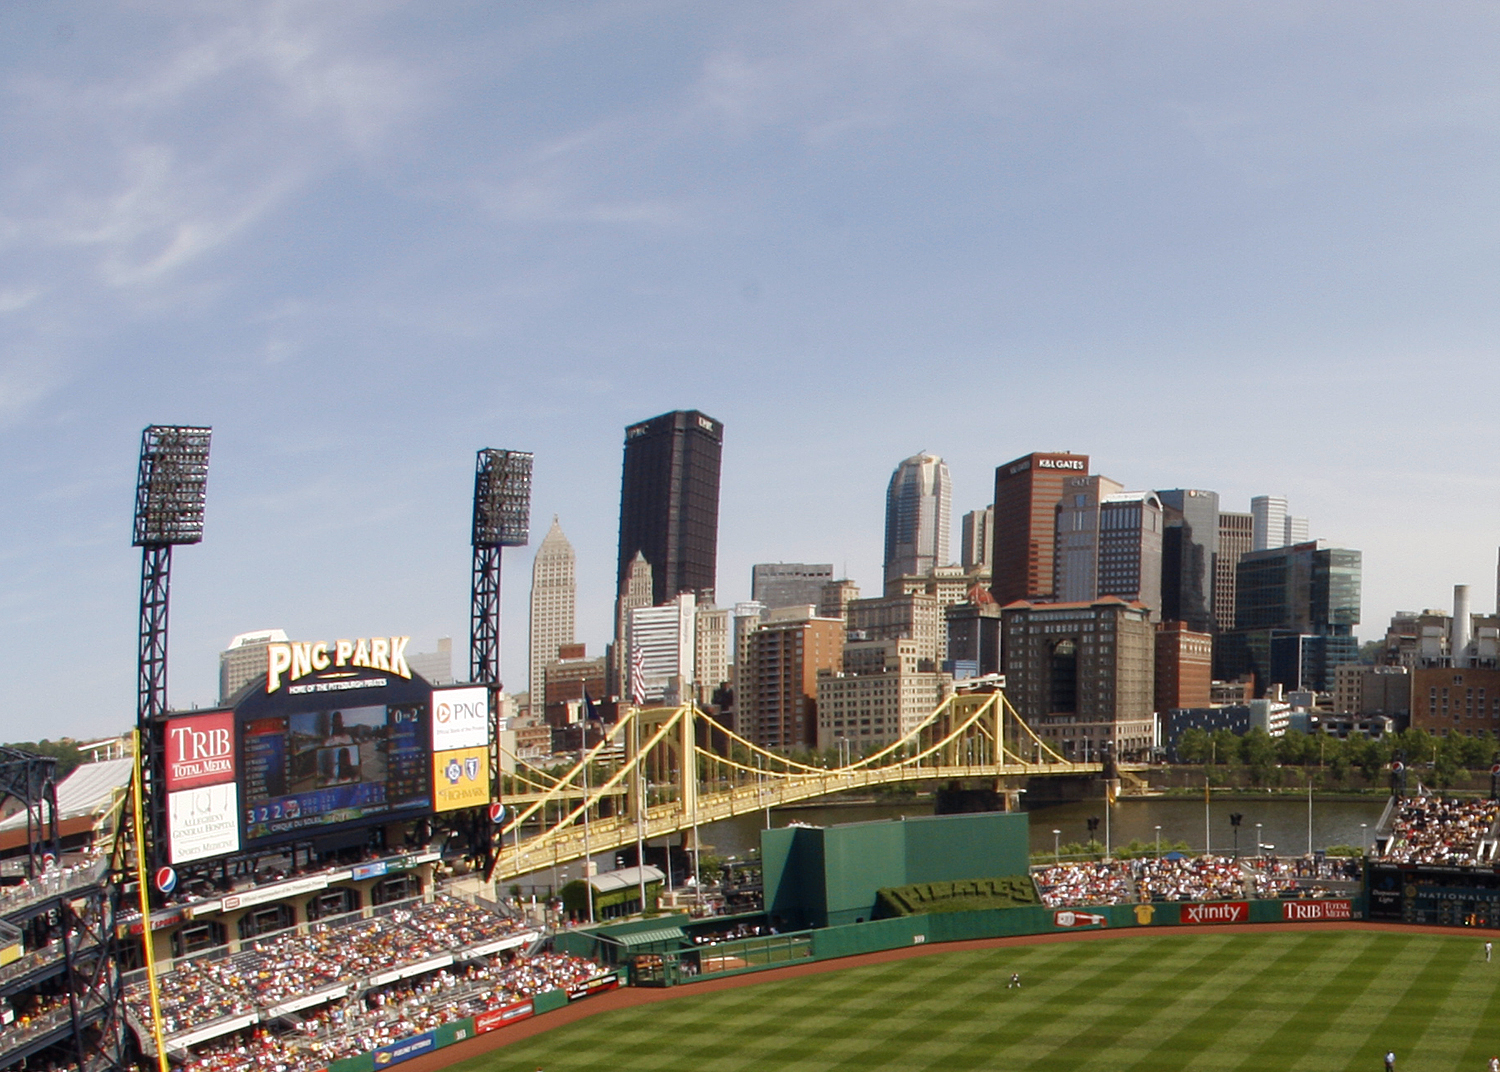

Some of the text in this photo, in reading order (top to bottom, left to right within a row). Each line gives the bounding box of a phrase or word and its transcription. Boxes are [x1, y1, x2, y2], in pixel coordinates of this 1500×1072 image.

[1039, 459, 1084, 470] K&L GATES
[265, 636, 412, 694] PNC PARK
[289, 685, 307, 695] HOME
[316, 683, 328, 692] THE
[453, 702, 485, 720] PNC
[171, 727, 231, 761] TRIB
[172, 759, 232, 777] TOTAL MEDIA
[444, 788, 486, 801] HIGHMARK
[173, 820, 236, 839] GENERAL HOSPITAL
[177, 845, 201, 857] SPORTS
[1418, 891, 1481, 902] NATIONAL
[1188, 904, 1241, 923] xfinity
[1283, 901, 1350, 919] TRIB TOTAL
[1325, 910, 1351, 918] MEDIA
